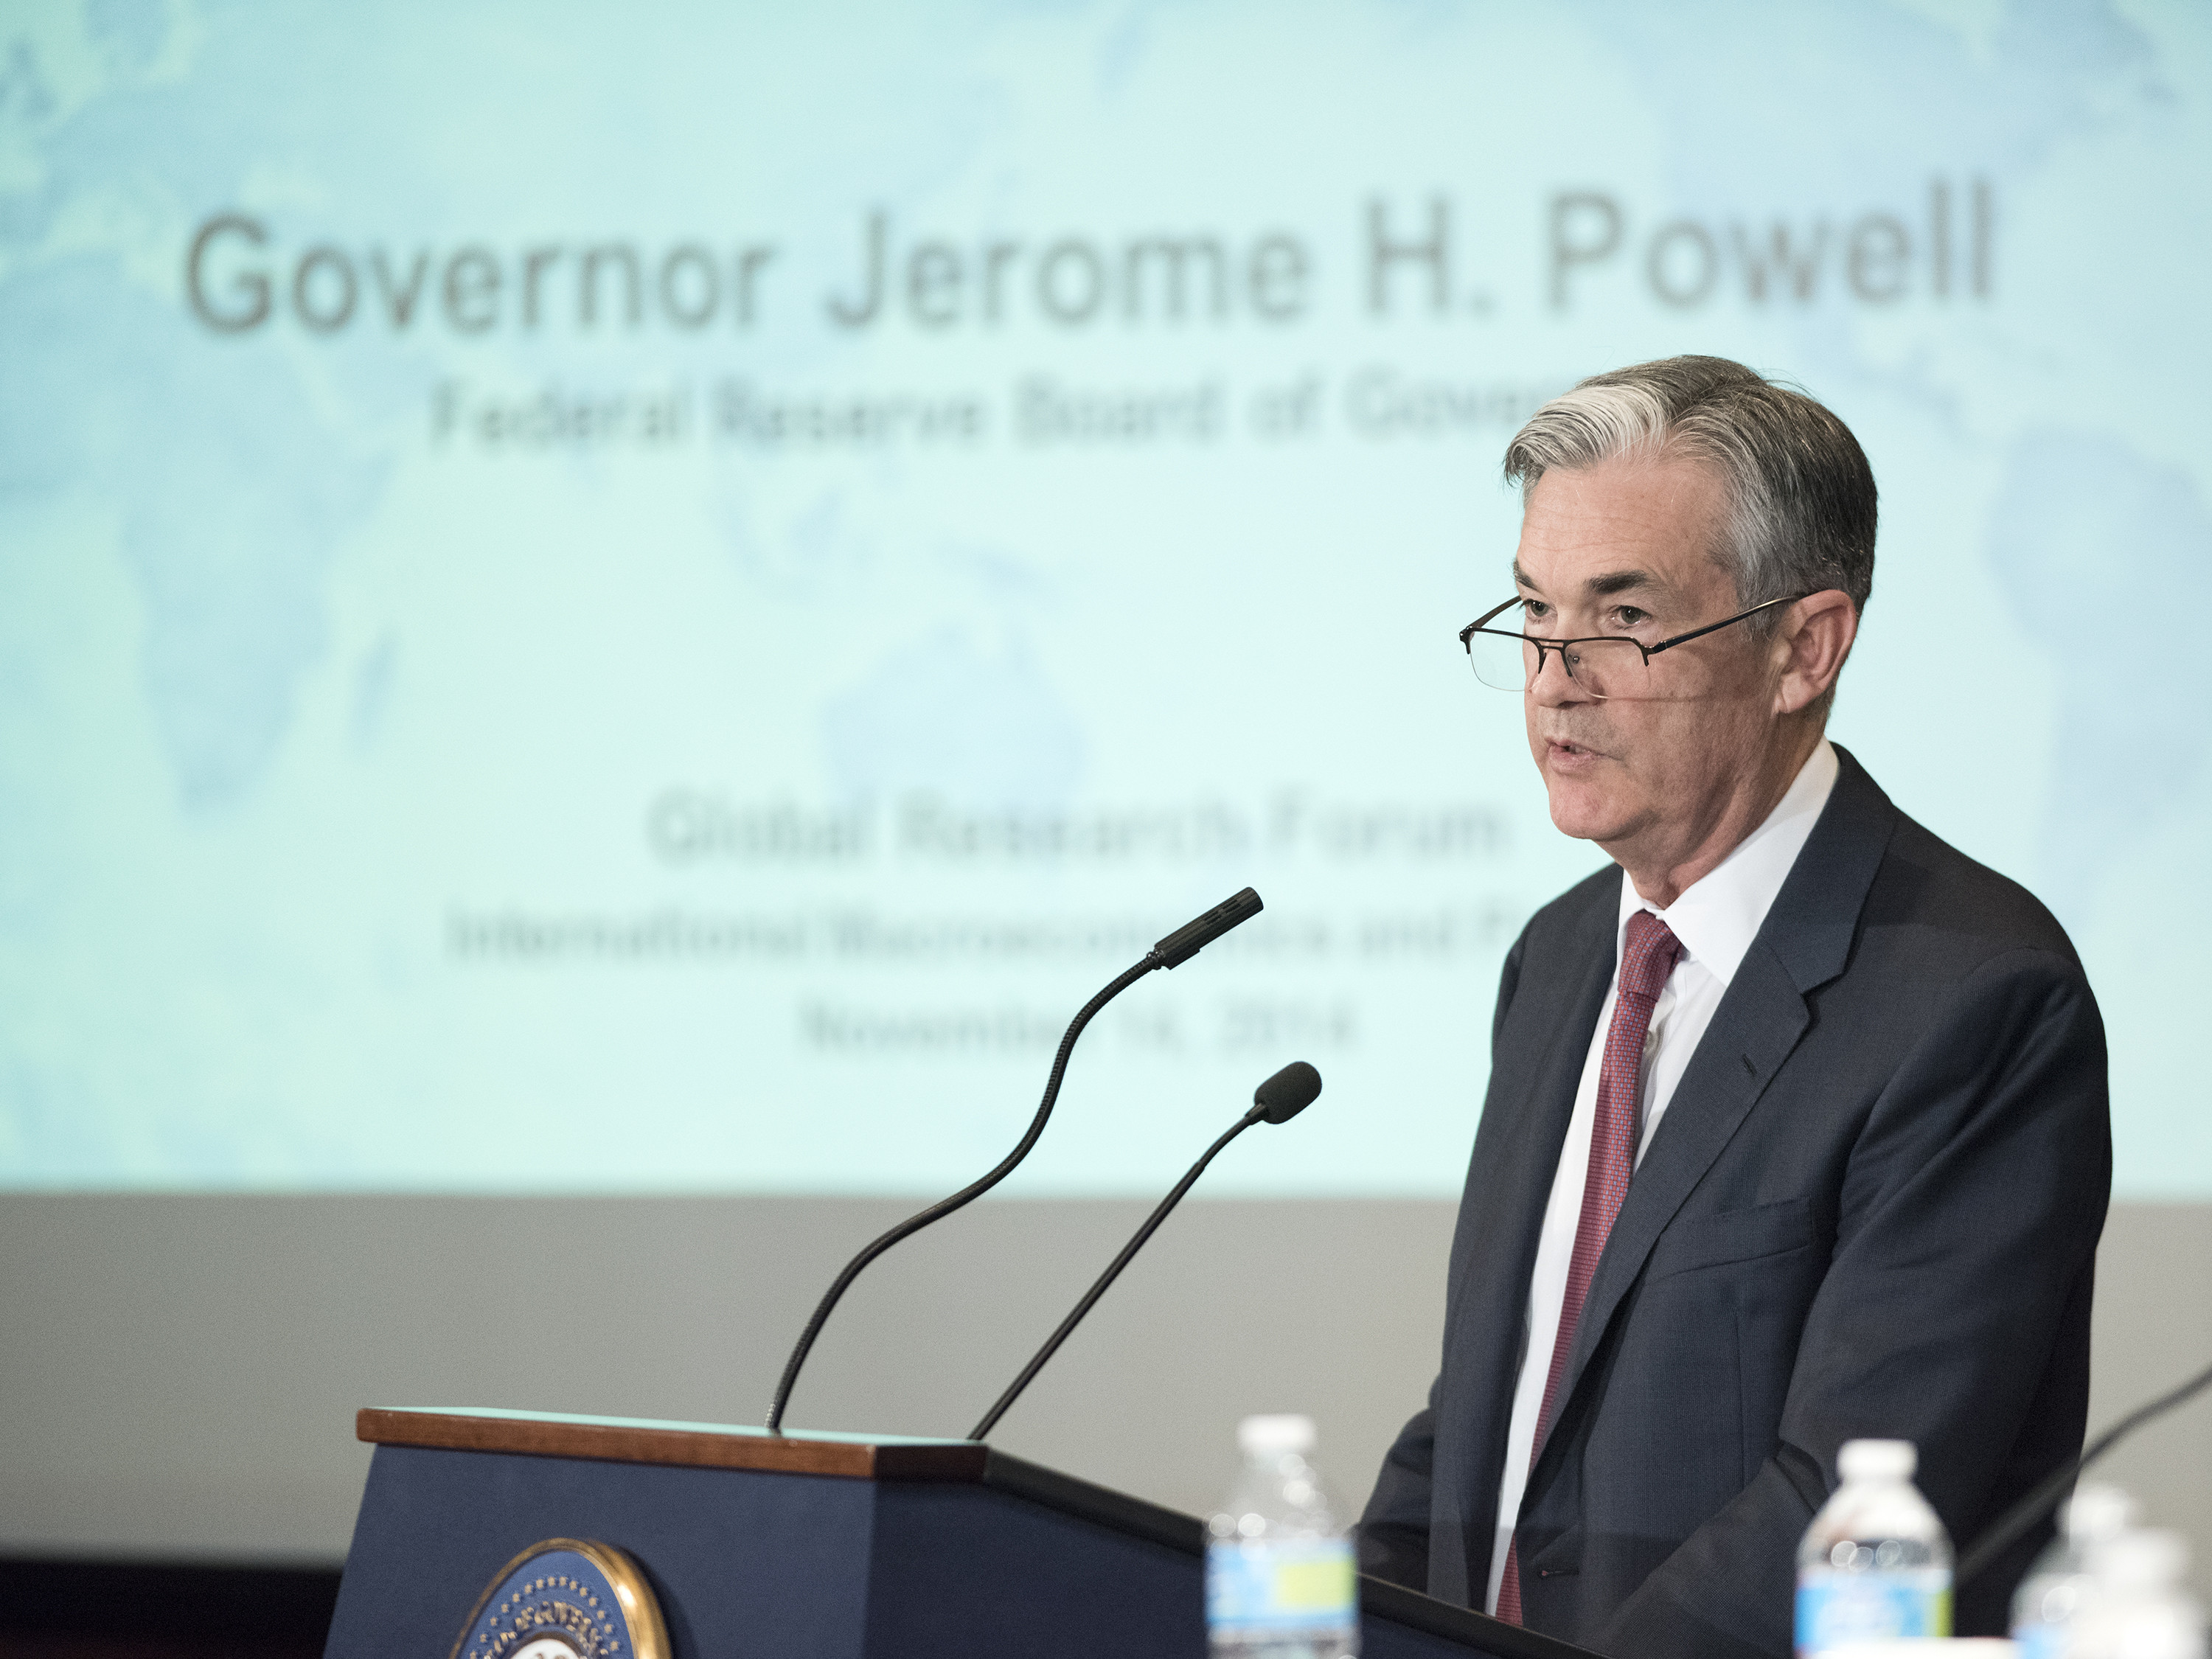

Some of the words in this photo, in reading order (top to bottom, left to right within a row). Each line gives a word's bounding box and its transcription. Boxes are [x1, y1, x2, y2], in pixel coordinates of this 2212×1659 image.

[186, 209, 779, 337] Governor
[824, 201, 1312, 333] Jerome
[1363, 190, 1495, 316] H.
[1544, 175, 1998, 315] Powell
[431, 377, 687, 453] Federal
[712, 375, 985, 451] Reserve
[1015, 370, 1225, 448] Board
[1246, 368, 1325, 446] of
[647, 786, 877, 868] Global
[895, 785, 1251, 868] Research
[1265, 783, 1517, 864] Forum
